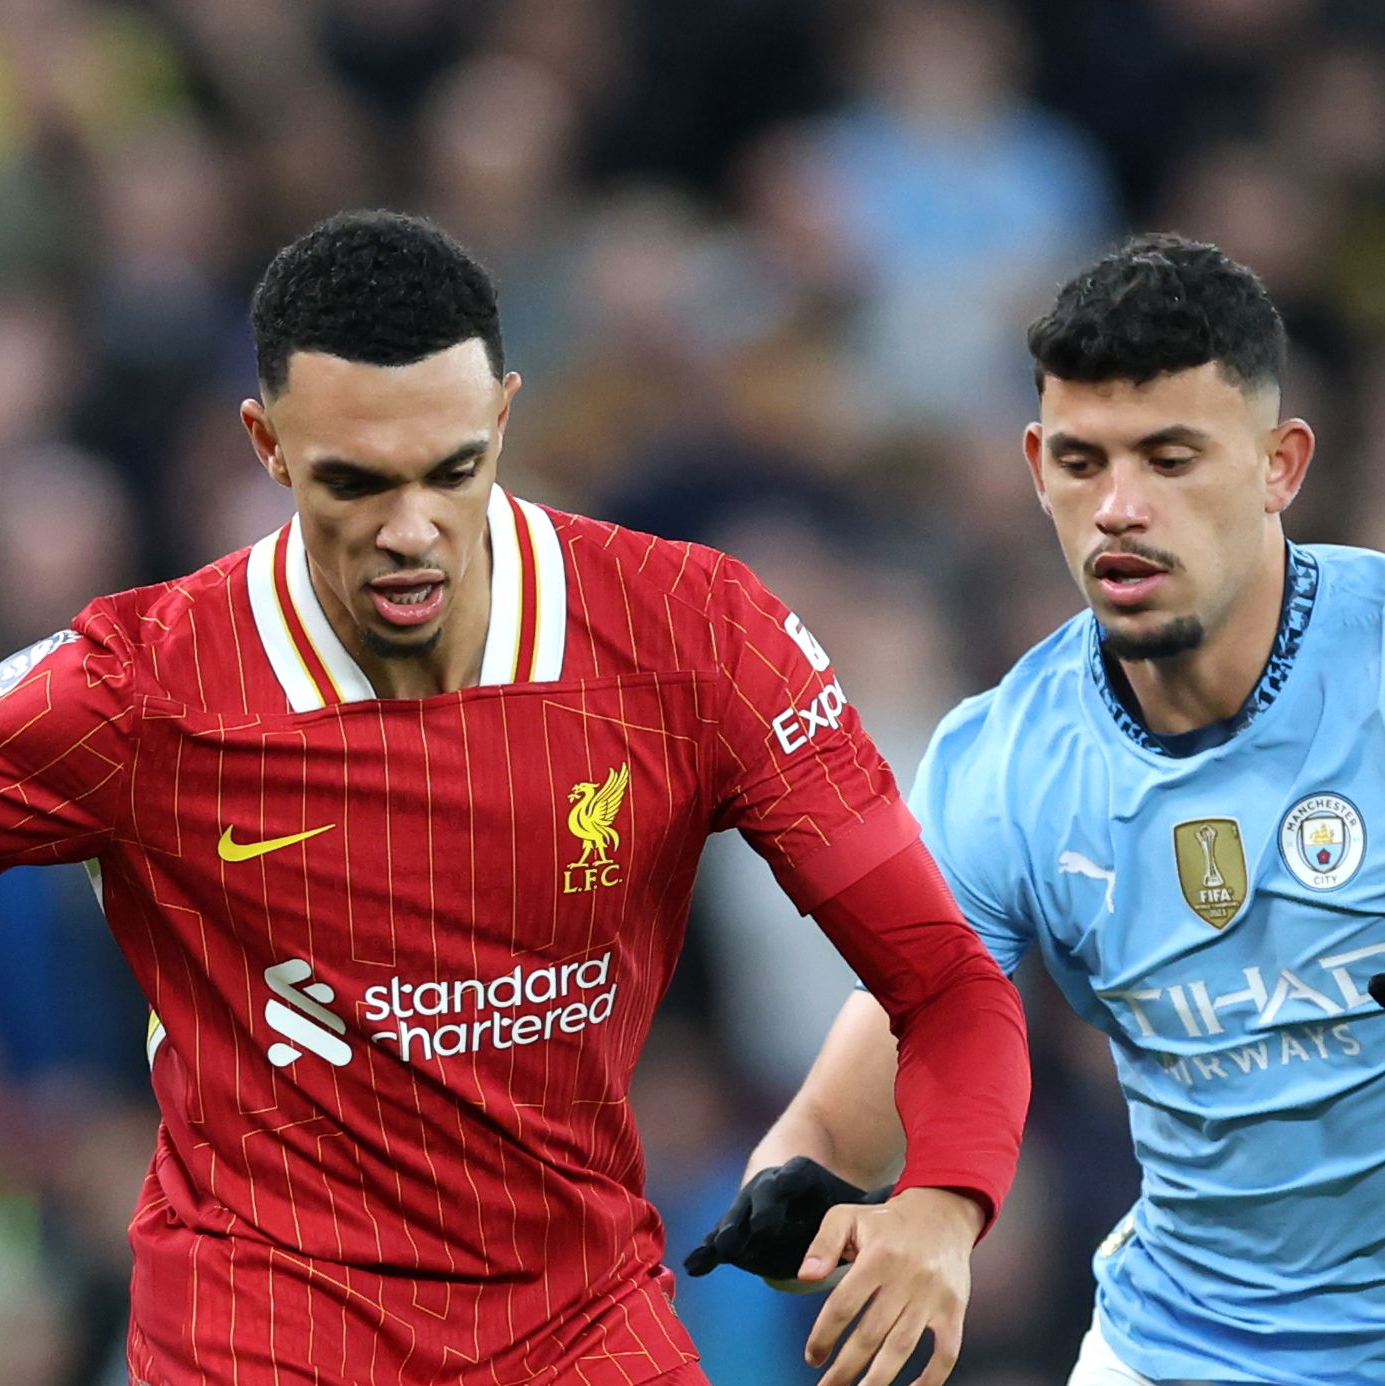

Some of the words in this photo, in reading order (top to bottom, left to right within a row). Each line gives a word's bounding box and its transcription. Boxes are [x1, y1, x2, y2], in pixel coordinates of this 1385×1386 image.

[772, 674, 847, 755] Exp
[1286, 798, 1358, 832] MANCHESTER
[563, 864, 623, 893] L.F.C.
[1313, 875, 1338, 886] CITY
[1199, 887, 1231, 903] FIFA
[364, 951, 611, 1022] standard
